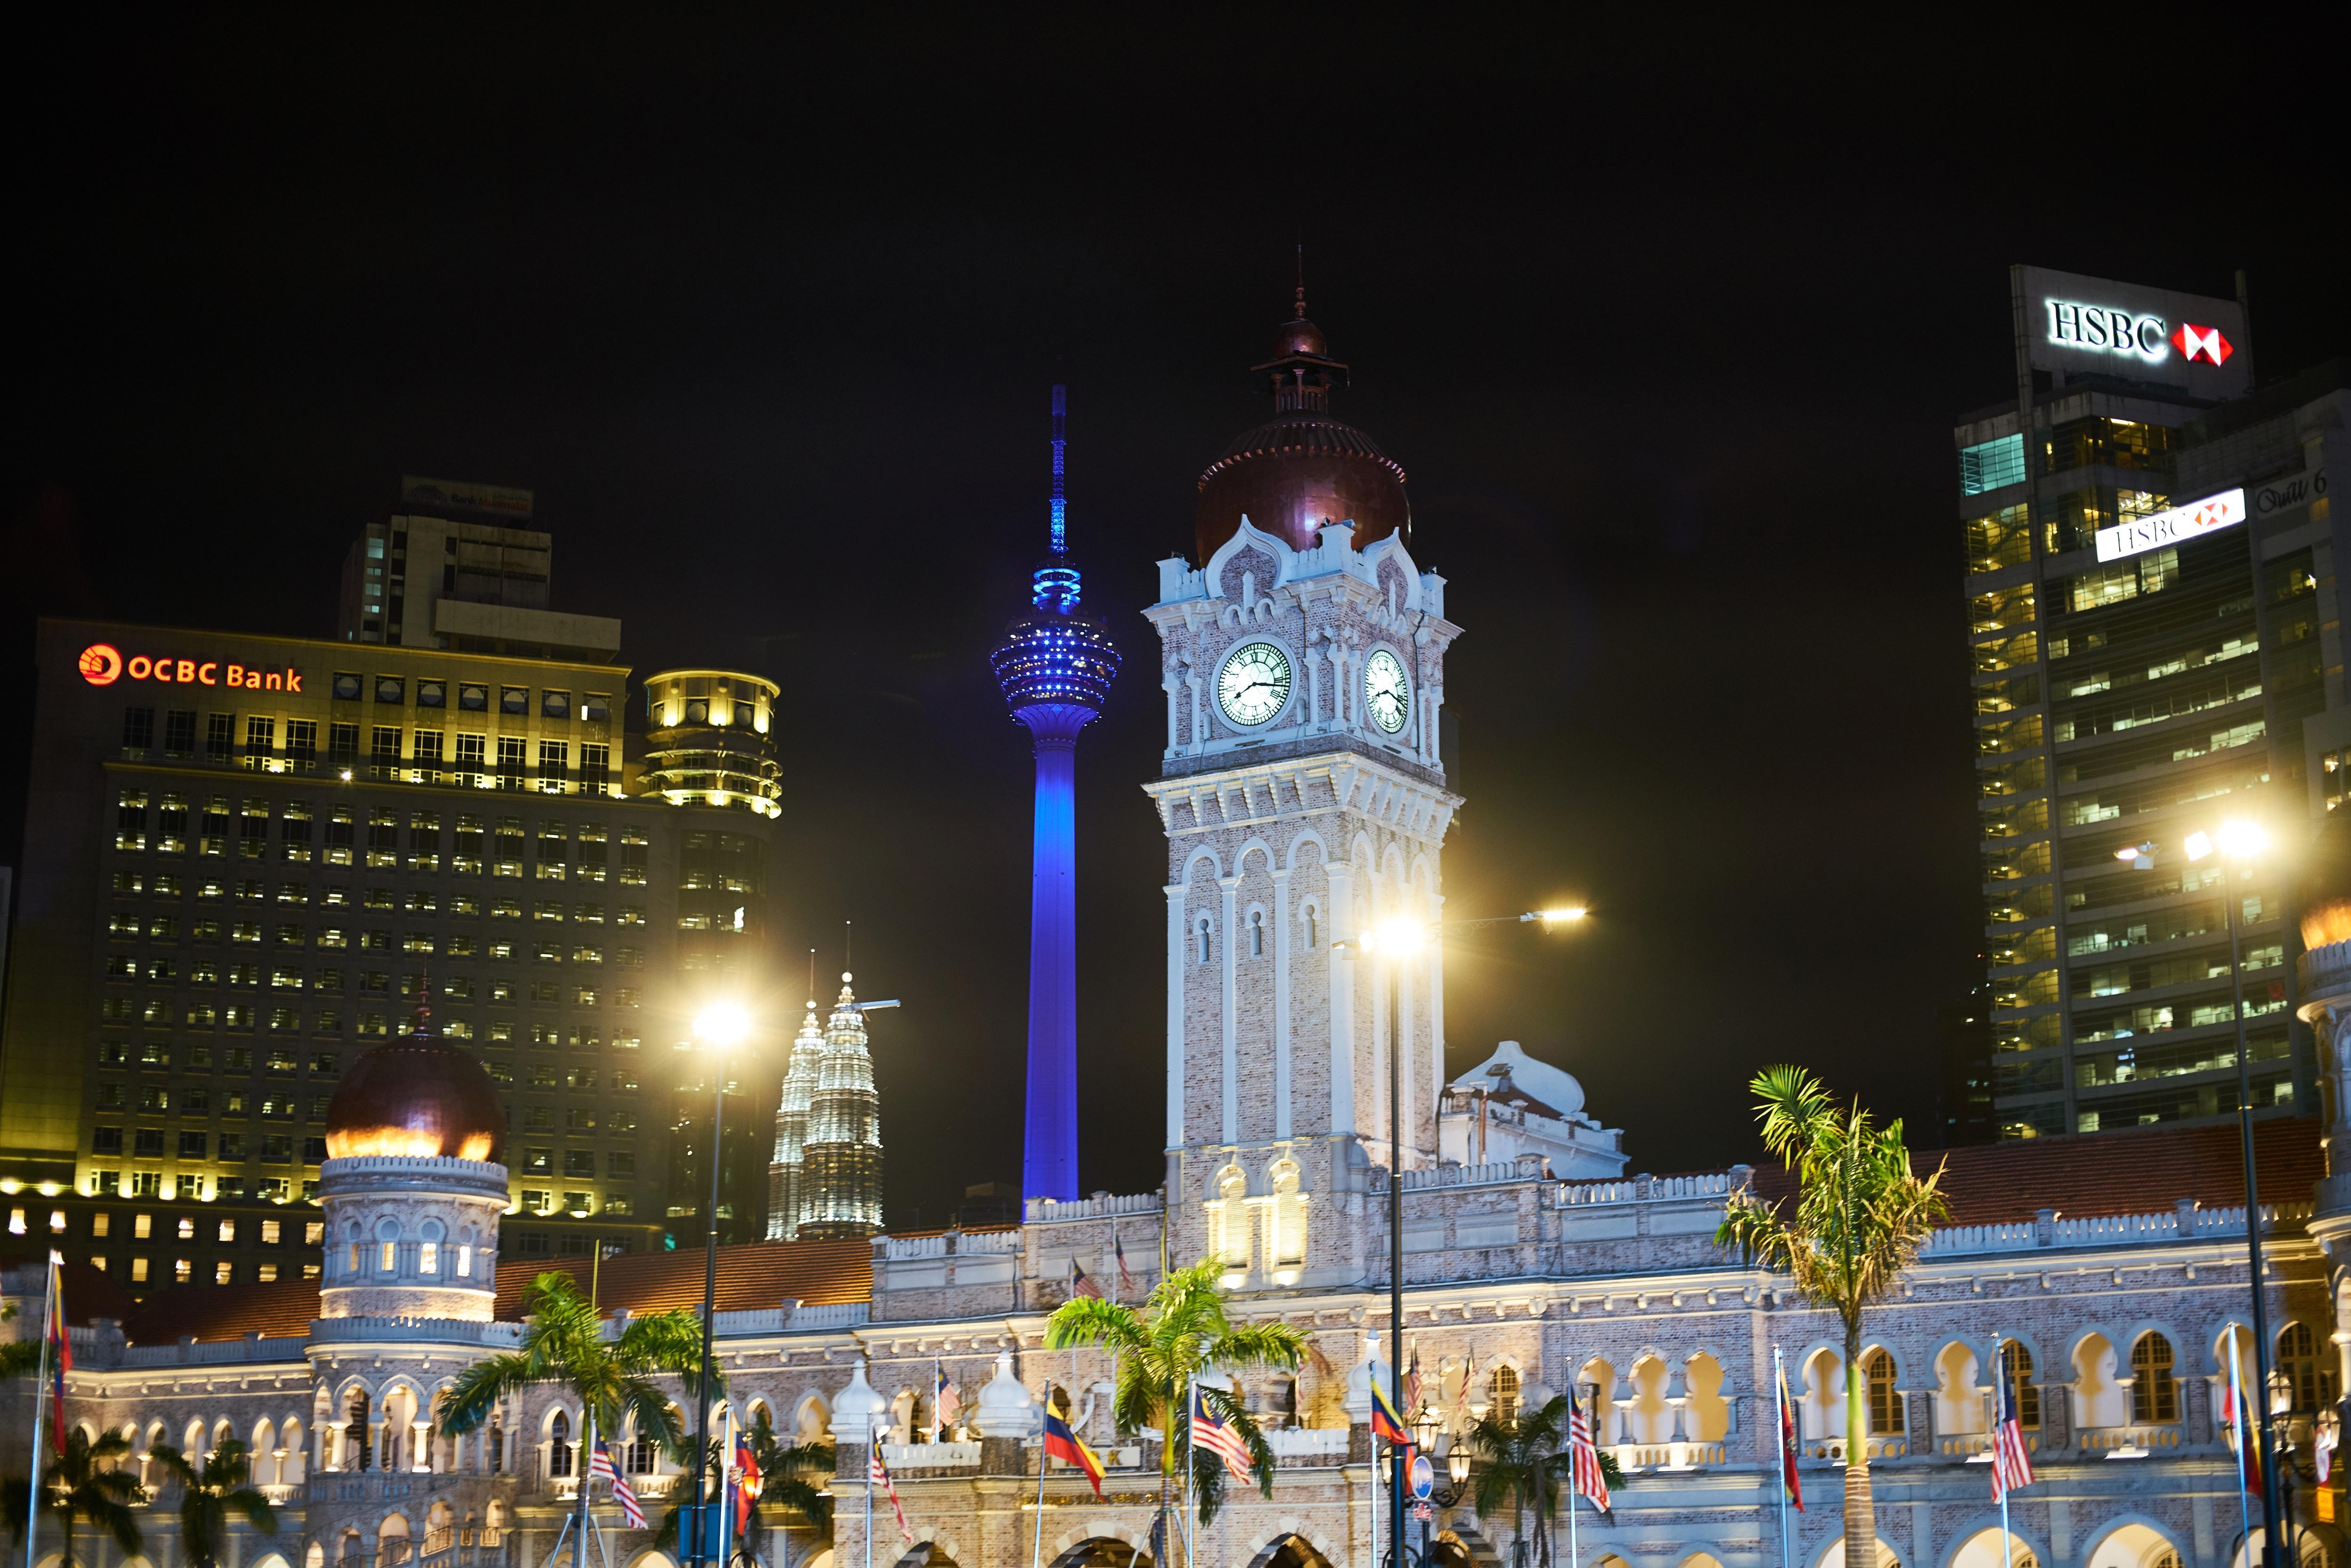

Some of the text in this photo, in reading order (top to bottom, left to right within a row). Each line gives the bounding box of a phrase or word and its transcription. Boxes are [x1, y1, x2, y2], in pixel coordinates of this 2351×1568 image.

[2049, 301, 2166, 355] HSBC
[2314, 467, 2327, 493] 6
[451, 493, 477, 505] Bank
[2116, 512, 2185, 552] HSBC
[128, 656, 302, 693] OCBC Bank
